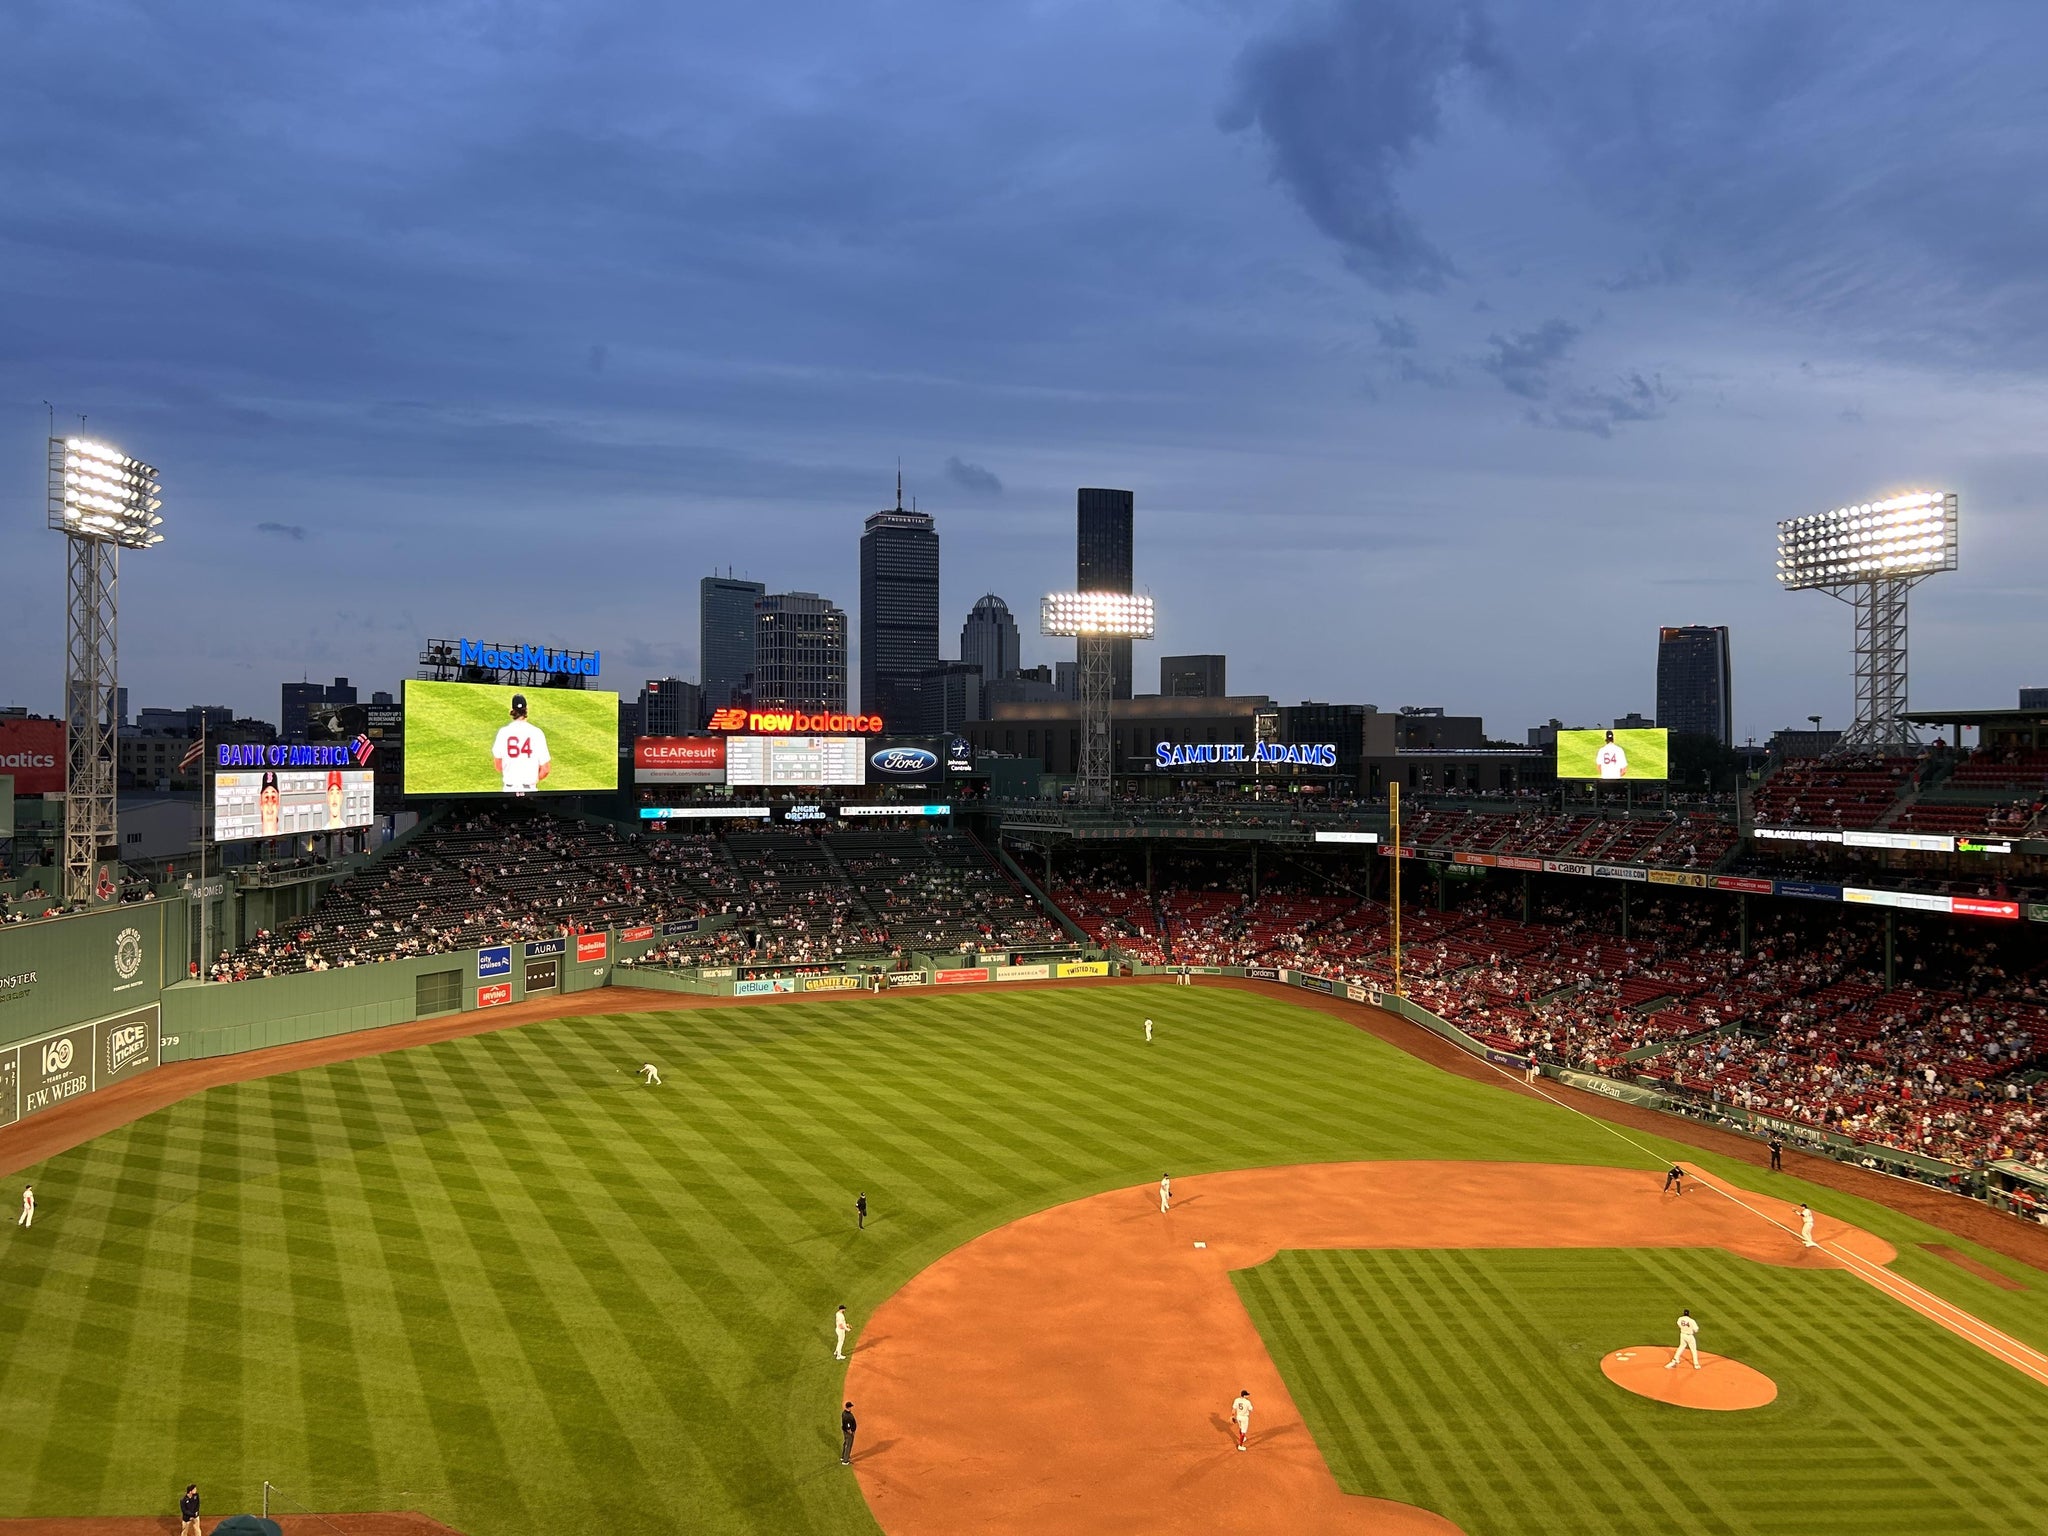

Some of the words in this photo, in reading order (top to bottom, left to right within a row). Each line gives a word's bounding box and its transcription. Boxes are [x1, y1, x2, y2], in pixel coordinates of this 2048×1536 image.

[460, 637, 600, 676] MassMutual
[750, 713, 794, 732] new
[795, 710, 883, 732] balance
[507, 736, 532, 758] 64
[644, 747, 716, 758] CLEAResult
[220, 744, 265, 766] BANK
[270, 745, 288, 766] OF
[290, 745, 349, 766] AMERICA
[1156, 742, 1250, 767] SAMUEL
[1251, 740, 1336, 767] ADAMS
[1603, 753, 1617, 765] 64
[884, 754, 924, 771] Ford
[791, 805, 820, 813] ANGRY
[785, 812, 826, 820] ORCHARD
[193, 884, 224, 899] ABOMED
[480, 956, 492, 964] city
[480, 961, 501, 970] cruises
[528, 971, 555, 980] VOLVO
[1067, 966, 1089, 975] TWISTED
[1089, 966, 1098, 974] TEA
[806, 977, 840, 990] GRANITE
[841, 976, 859, 988] CITY
[889, 972, 921, 983] wasabi
[738, 982, 769, 994] jetBlue
[483, 989, 507, 1001] IRVING
[115, 1025, 145, 1051] ACE
[160, 1036, 180, 1047] 379
[115, 1040, 145, 1063] TICKET
[26, 1087, 49, 1112] F.W.
[51, 1075, 87, 1101] WEBB
[1756, 1115, 1768, 1125] JIM
